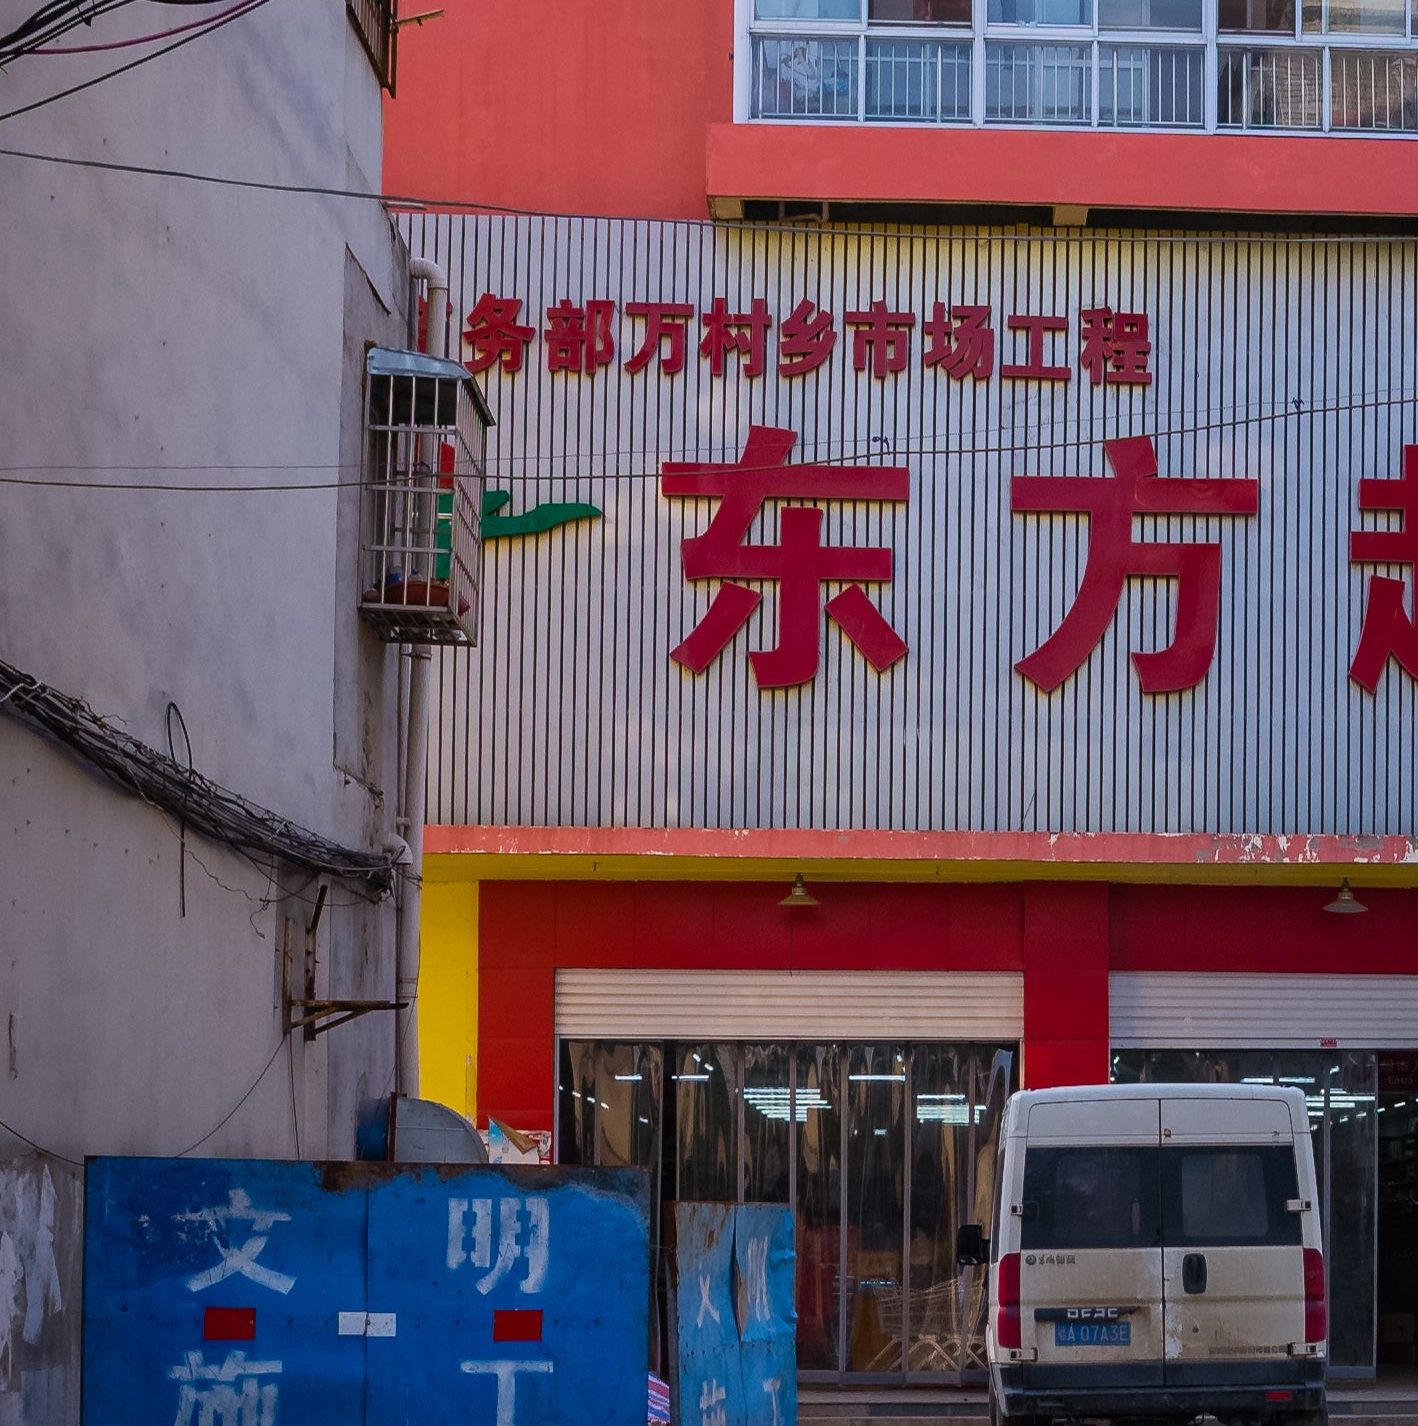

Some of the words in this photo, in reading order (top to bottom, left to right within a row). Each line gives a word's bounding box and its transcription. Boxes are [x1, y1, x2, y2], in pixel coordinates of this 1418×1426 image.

[417, 293, 1153, 385] 务部万村乡市场工程
[187, 1188, 552, 1295] 文明
